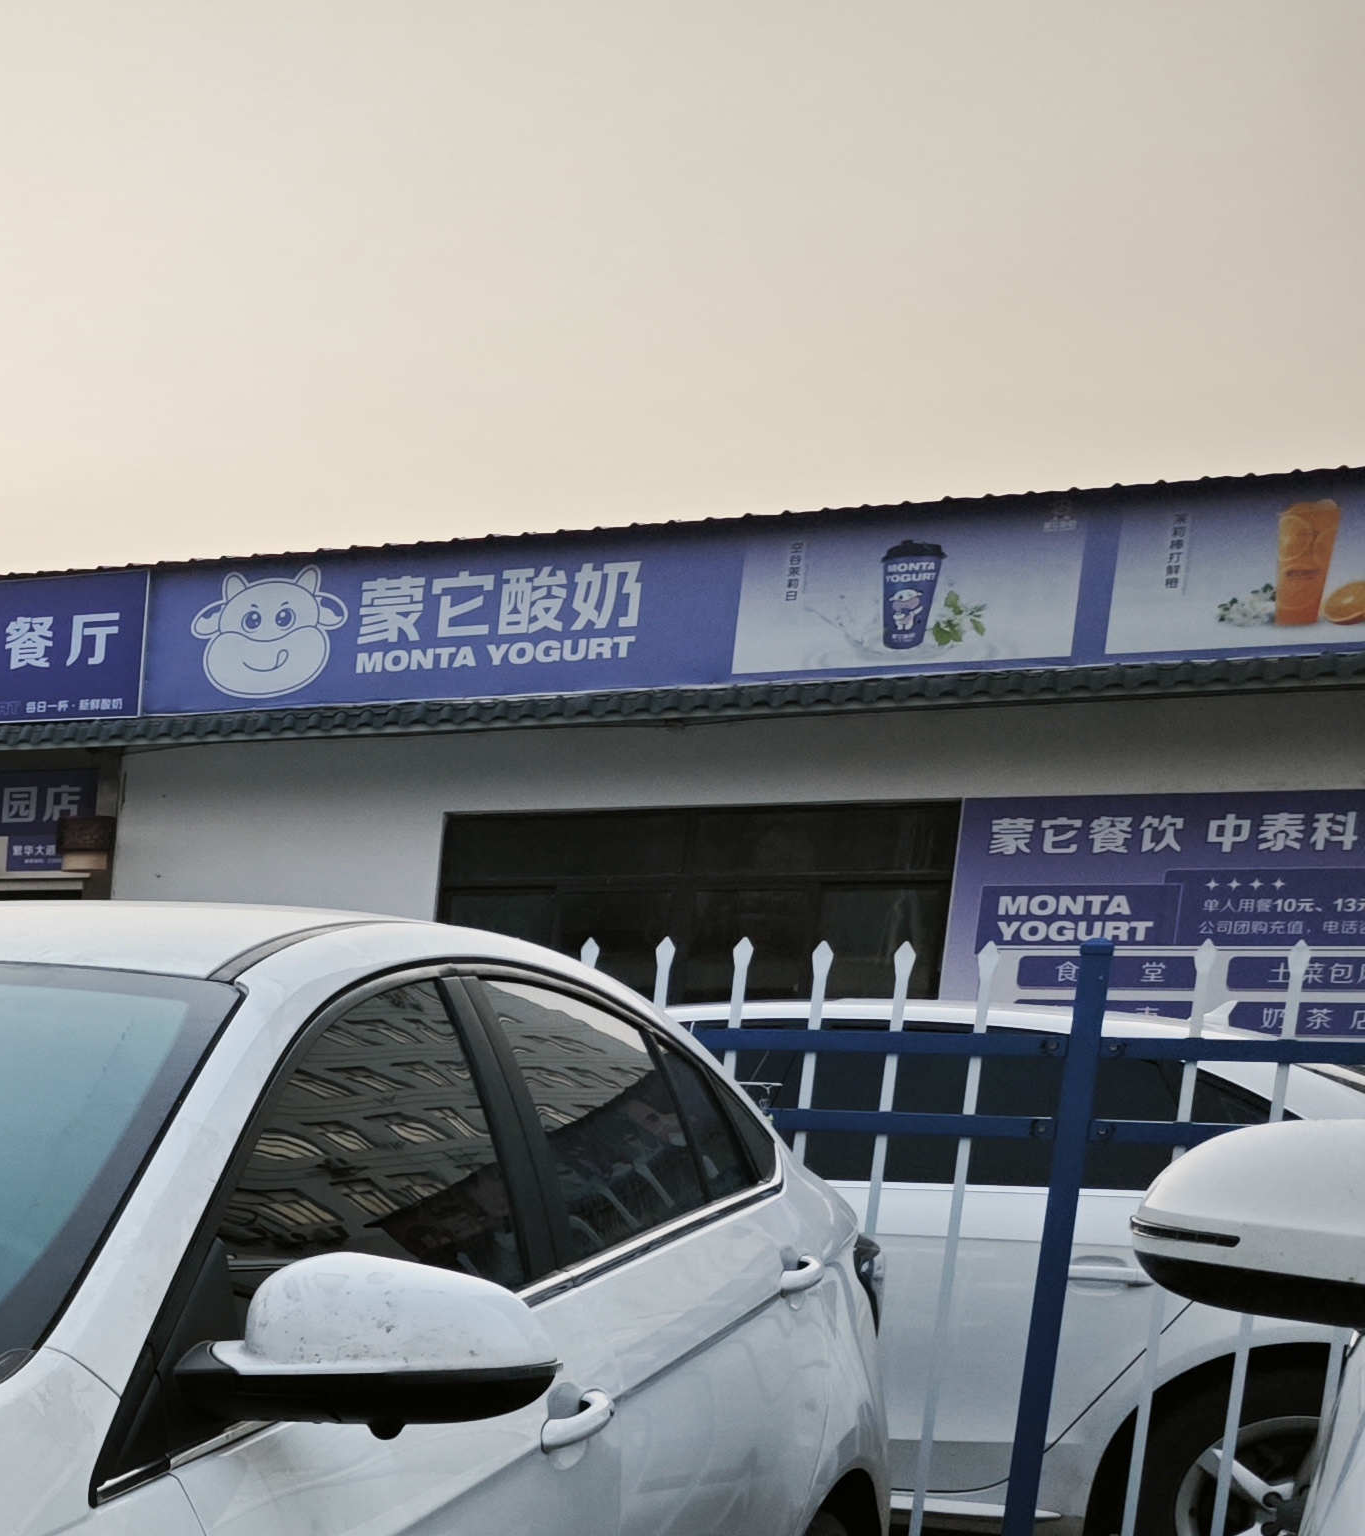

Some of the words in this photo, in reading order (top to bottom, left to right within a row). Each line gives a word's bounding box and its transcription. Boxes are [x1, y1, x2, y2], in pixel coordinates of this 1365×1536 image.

[886, 572, 937, 583] YOGURT
[887, 562, 936, 572] MONTA
[356, 561, 643, 645] 蒙它酸奶
[355, 645, 476, 674] MONTA
[486, 635, 637, 667] YOGURT
[988, 814, 1185, 856] 蒙它餐饮
[1206, 811, 1358, 853] 中泰科
[997, 895, 1132, 916] MONTA
[997, 921, 1155, 942] YOGURT
